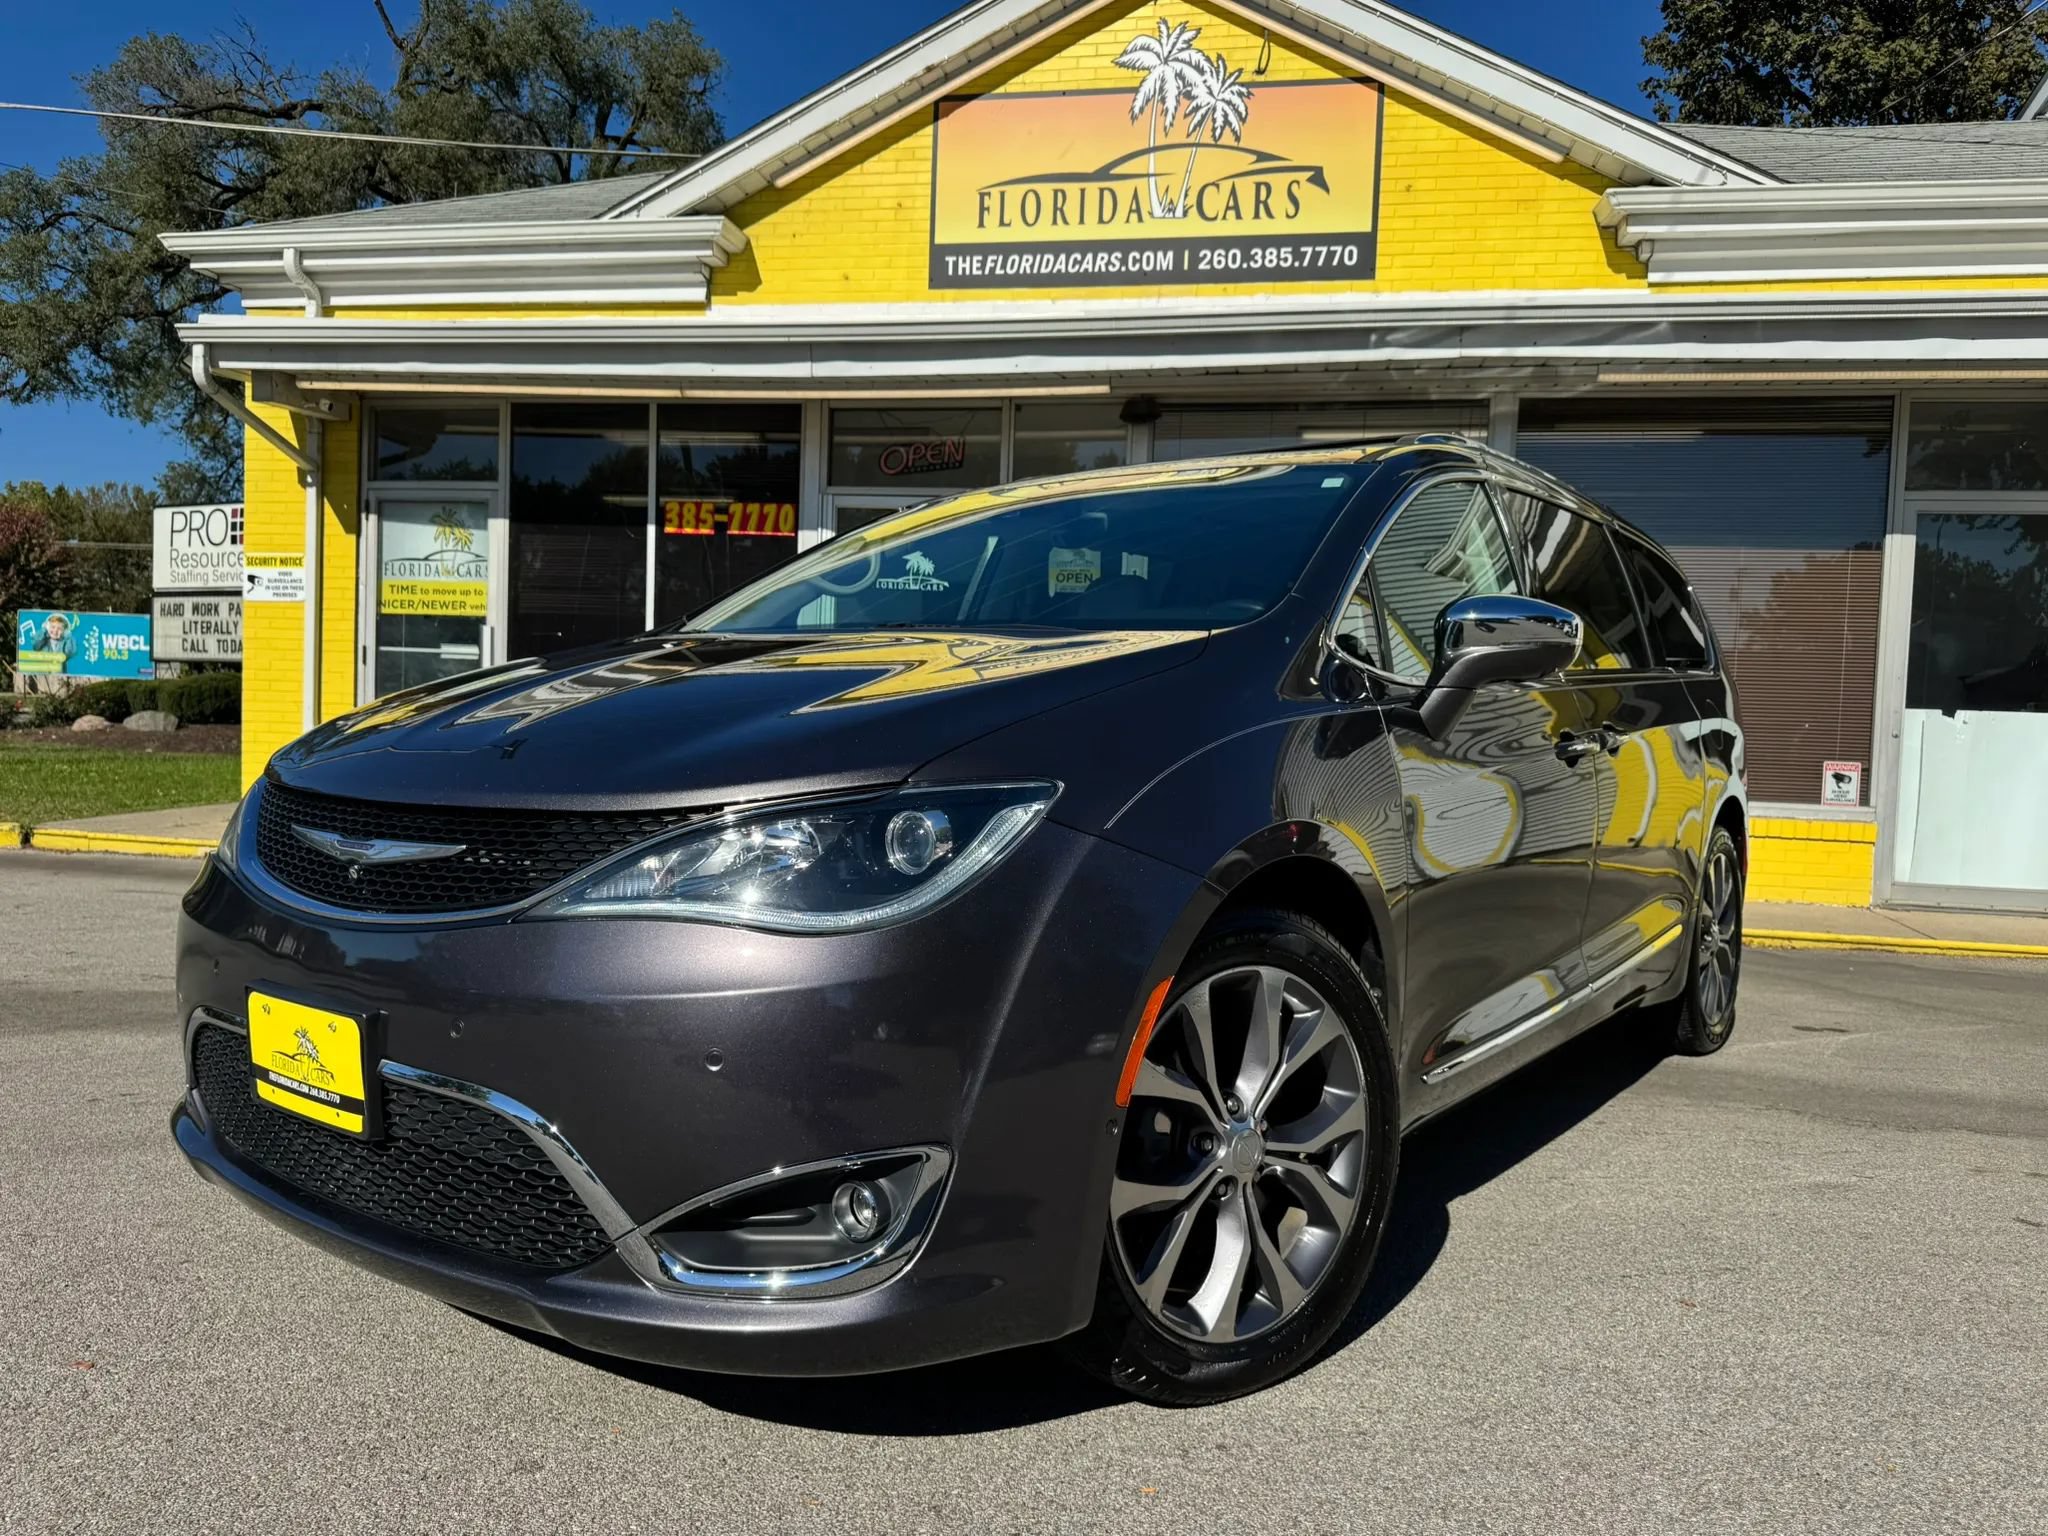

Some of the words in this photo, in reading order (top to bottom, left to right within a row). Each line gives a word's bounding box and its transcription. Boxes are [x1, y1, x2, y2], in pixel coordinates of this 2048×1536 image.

[976, 186, 1145, 229] FLORIDA
[1195, 179, 1301, 222] CARS
[944, 250, 1174, 276] THEFLORIDACARS.COM
[1198, 245, 1359, 270] 260.385.7770
[880, 438, 965, 476] OPEN
[665, 502, 796, 532] 385-7770
[170, 508, 229, 548] PRO
[246, 556, 278, 567] SECURITY
[279, 556, 304, 567] NOTICE
[384, 562, 440, 578] FLORIDA
[170, 571, 209, 585] Staffing
[1056, 572, 1094, 584] OPEN
[389, 584, 418, 596] TIME
[420, 586, 430, 596] to
[432, 588, 457, 596] move
[460, 588, 472, 598] up
[474, 587, 484, 596] to
[160, 603, 185, 617] HARD
[192, 602, 220, 616] WORK
[182, 620, 240, 635] LITERALLY
[102, 634, 150, 650] WBCL
[182, 638, 208, 653] CALL
[103, 649, 129, 660] 90.3
[271, 1054, 301, 1076] FLORIDA
[310, 1068, 330, 1086] CARS
